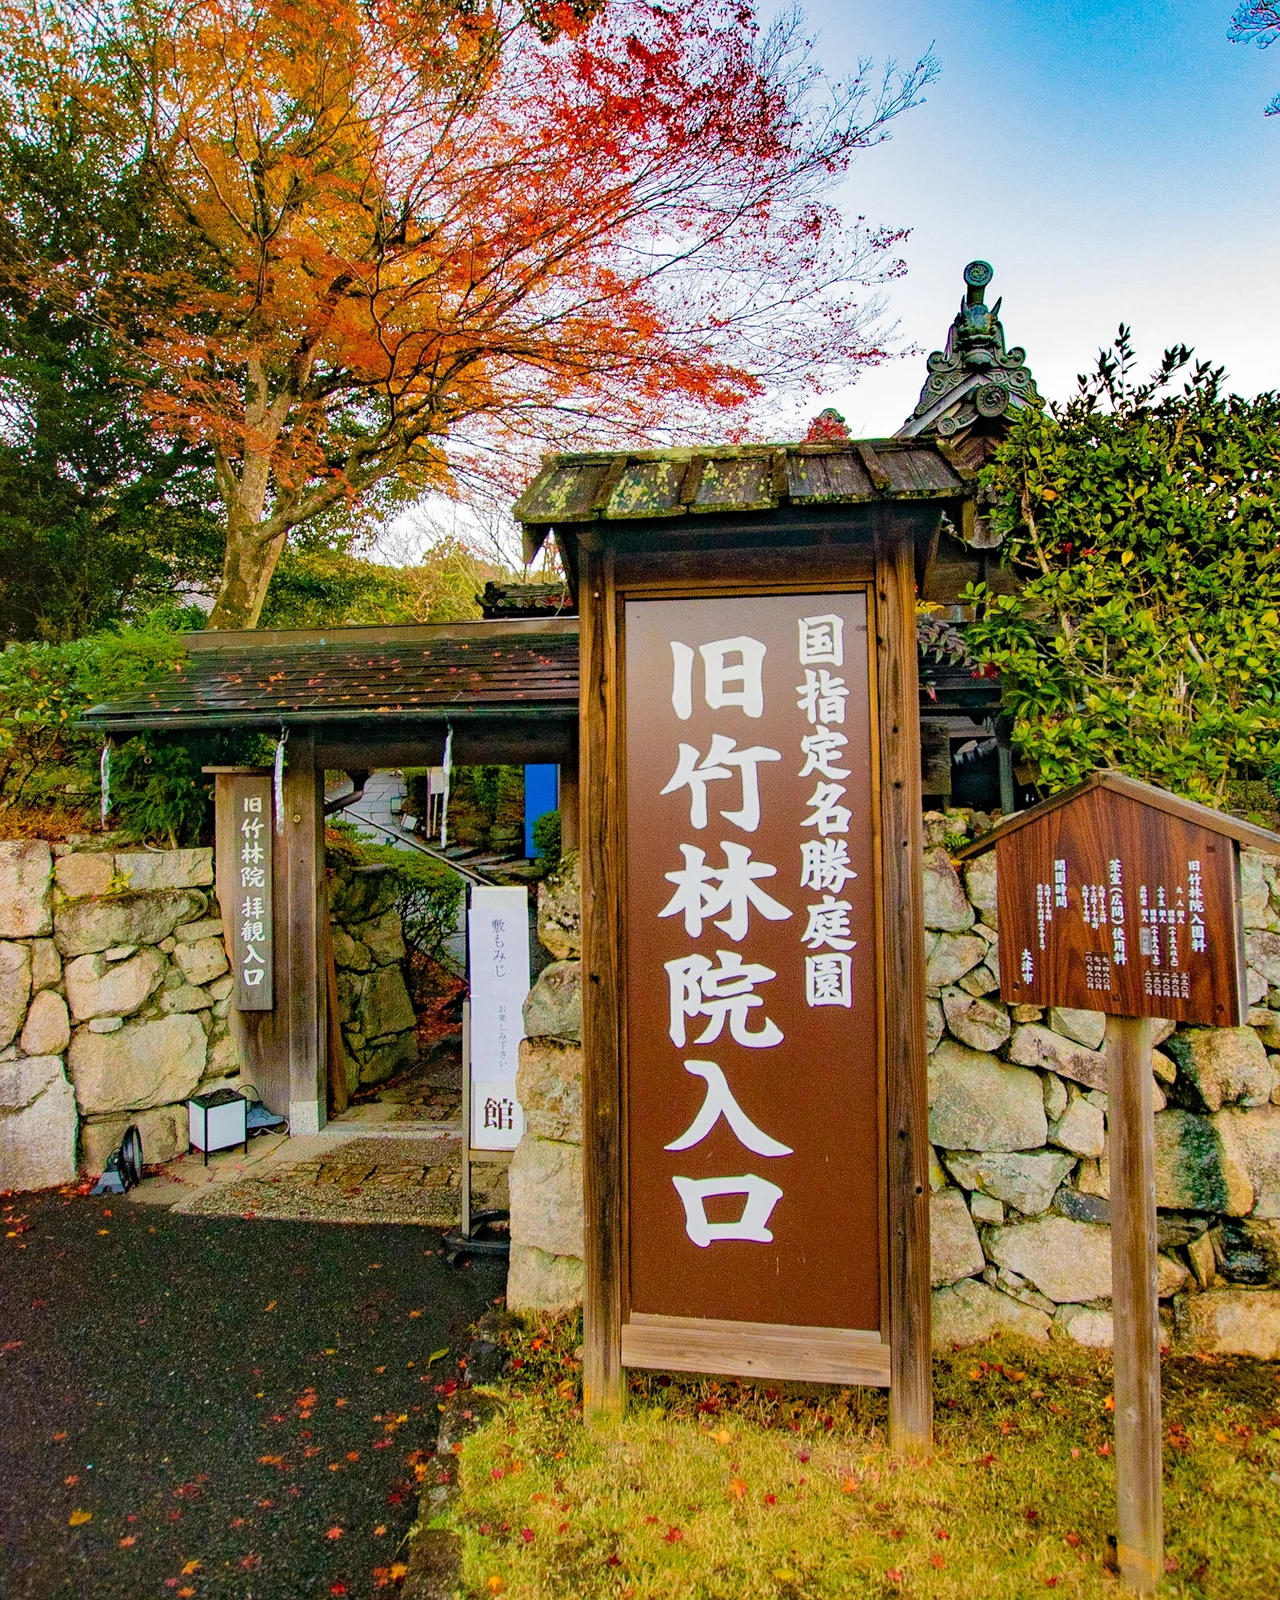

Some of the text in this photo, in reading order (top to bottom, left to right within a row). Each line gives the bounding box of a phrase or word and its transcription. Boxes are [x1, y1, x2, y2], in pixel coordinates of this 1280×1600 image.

[796, 614, 858, 1009] 国指定名勝庭園
[1054, 859, 1068, 909] 開園時間
[1188, 860, 1207, 953] 旧竹林院入園料
[657, 635, 794, 1249] 旧竹林院入口
[1021, 948, 1034, 985] 大津市
[483, 1097, 514, 1131] 館
